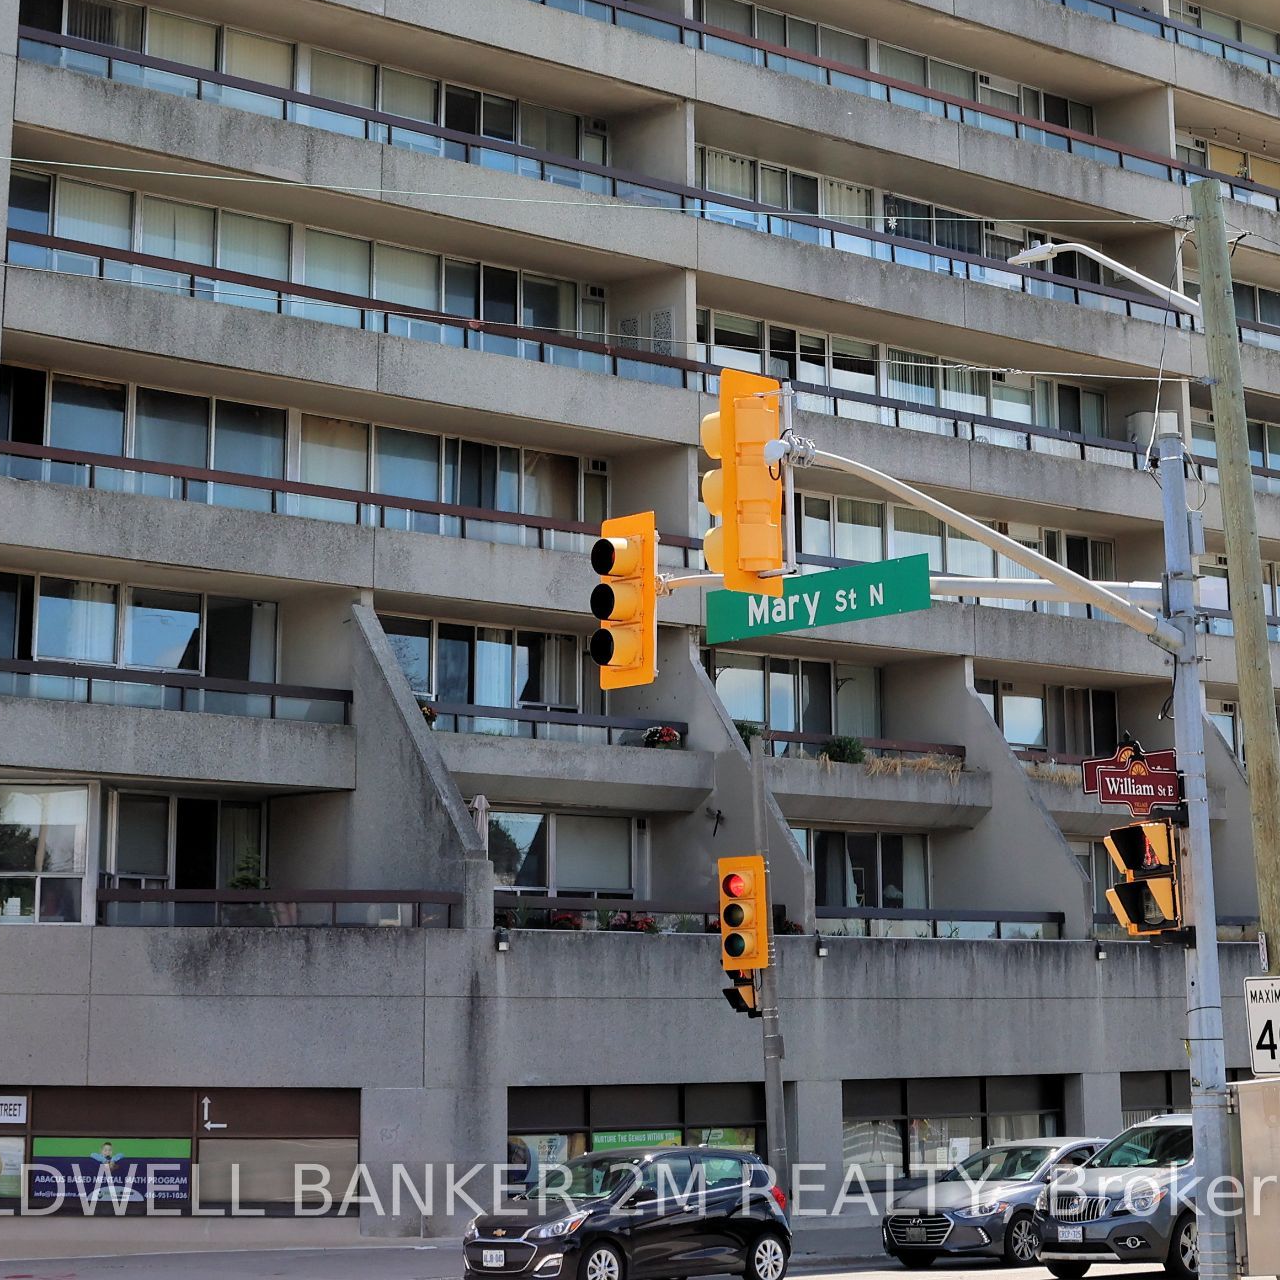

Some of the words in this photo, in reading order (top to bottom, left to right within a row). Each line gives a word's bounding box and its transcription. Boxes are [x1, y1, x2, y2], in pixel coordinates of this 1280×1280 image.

[748, 591, 821, 627] Mary
[834, 588, 857, 612] St
[870, 583, 884, 607] N
[1105, 777, 1155, 796] William
[1157, 785, 1166, 796] St
[1167, 785, 1174, 797] E
[595, 1135, 617, 1143] NURTURE
[618, 1134, 628, 1142] THE
[35, 1176, 66, 1184] ABACUS
[67, 1176, 92, 1184] BASED
[93, 1176, 123, 1184] MENTAL
[148, 1177, 188, 1185] PROGRAM
